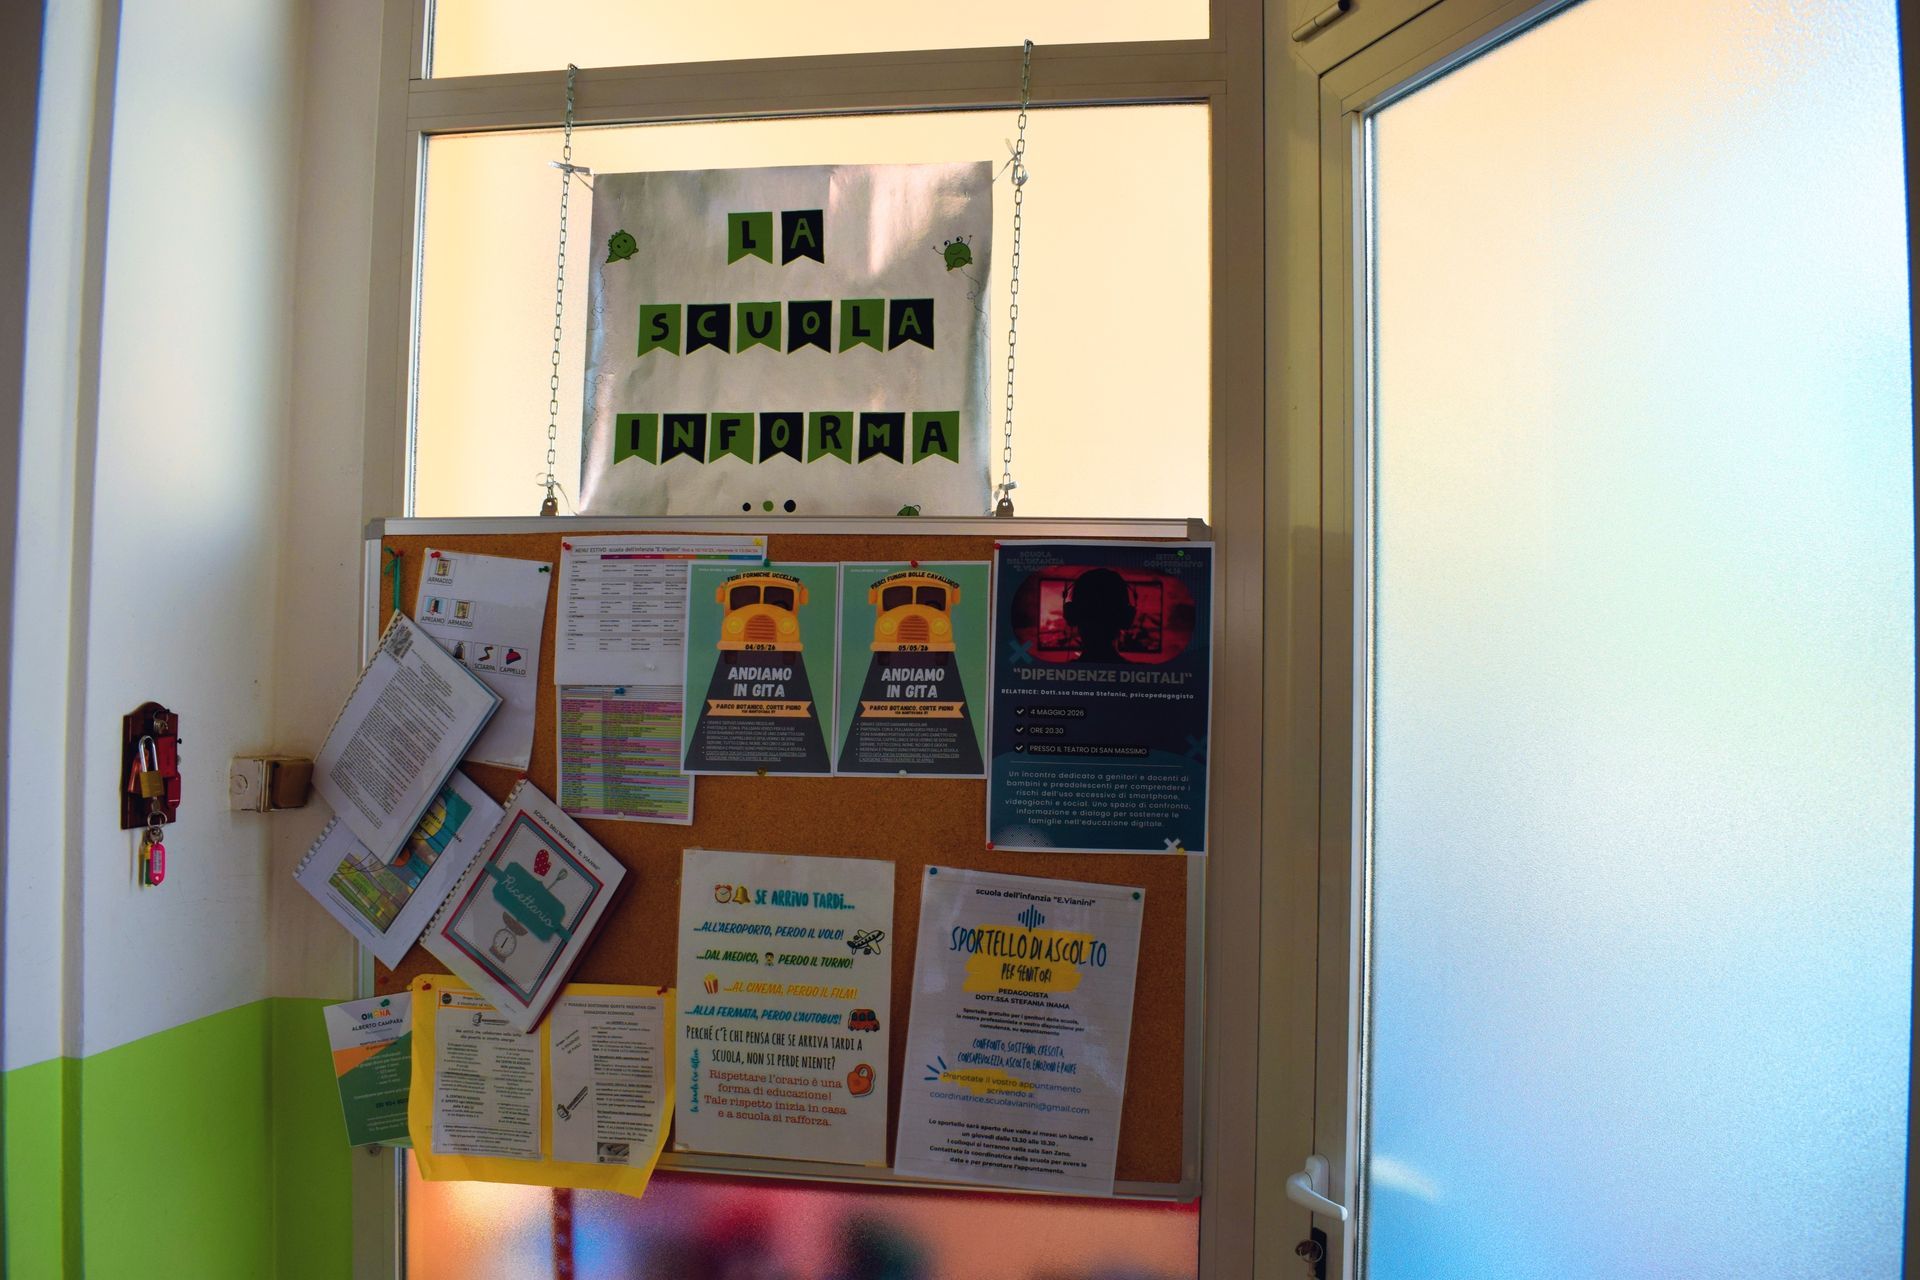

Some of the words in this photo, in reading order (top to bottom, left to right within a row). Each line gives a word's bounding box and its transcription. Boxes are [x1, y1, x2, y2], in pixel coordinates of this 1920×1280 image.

[741, 217, 816, 249] LA
[651, 305, 922, 341] SCUOLA
[630, 415, 948, 453] INFORMA
[474, 663, 496, 671] SCIARPA
[500, 667, 526, 675] CAPPELLO
[728, 666, 792, 680] ANDIAMO
[881, 668, 945, 682] ANDIAMO
[1013, 668, 1116, 683] "DIPENDENZE
[1119, 671, 1193, 684] DIGITALI"
[733, 683, 747, 697] IN
[752, 684, 785, 697] GITA
[886, 684, 900, 698] IN
[905, 685, 938, 698] GITA
[755, 889, 766, 904] SE
[772, 890, 808, 907] ARRIVO
[976, 888, 1001, 897] scuola
[1003, 891, 1051, 902] dell'infanzia
[775, 926, 806, 937] PERDO
[808, 928, 816, 938] IL
[818, 929, 844, 940] VOLO!
[950, 926, 1027, 959] SPORTELLO
[1030, 936, 1042, 960] DI
[1045, 937, 1107, 967] ASCOLTO
[722, 951, 759, 964] MEDICO,
[778, 954, 809, 966] PERDO
[810, 956, 818, 966] IL
[821, 957, 854, 968] TURNO!
[1001, 963, 1014, 980] PER
[1017, 965, 1052, 983] GENITORI
[746, 982, 784, 995] CINEMA,
[787, 985, 819, 996] PERDO
[821, 986, 829, 997] IL
[831, 986, 857, 999] FILM!
[998, 988, 1048, 999] PEDAGOGISTA
[1011, 998, 1044, 1007] STEFANIA
[717, 1007, 758, 1020] FERMATA,
[761, 1010, 791, 1021] PERDO
[793, 1012, 842, 1024] L'AUTOBUS!
[352, 1021, 377, 1031] ALBERTO
[730, 1029, 743, 1042] CHI
[746, 1031, 770, 1044] PENSA
[772, 1032, 785, 1045] CHE
[788, 1034, 796, 1045] SE
[798, 1035, 828, 1049] ARRIVA
[831, 1038, 854, 1050] TARDI
[857, 1040, 863, 1051] A
[712, 1049, 744, 1065] SCUOLA,
[747, 1053, 764, 1064] NON
[767, 1054, 775, 1065] SI
[777, 1054, 799, 1067] PERDE
[802, 1056, 835, 1071] NIENTE?
[709, 1069, 766, 1083] Rispettare
[768, 1074, 810, 1086] l'orario
[820, 1079, 842, 1088] una
[942, 1072, 983, 1083] Prenotate
[986, 1076, 990, 1084] il
[992, 1077, 1017, 1087] vostro
[1019, 1081, 1081, 1094] appuntamento
[718, 1083, 751, 1094] forma
[753, 1085, 763, 1095] di
[767, 1087, 832, 1100] educazione!
[986, 1087, 1025, 1097] scrivendo
[704, 1095, 727, 1106] Tale
[729, 1098, 772, 1110] rispetto
[775, 1101, 805, 1112] inizia
[808, 1103, 818, 1112] in
[821, 1106, 847, 1115] casa
[736, 1110, 771, 1121] scuola
[773, 1113, 782, 1122] si
[785, 1114, 832, 1126] rafforza.
